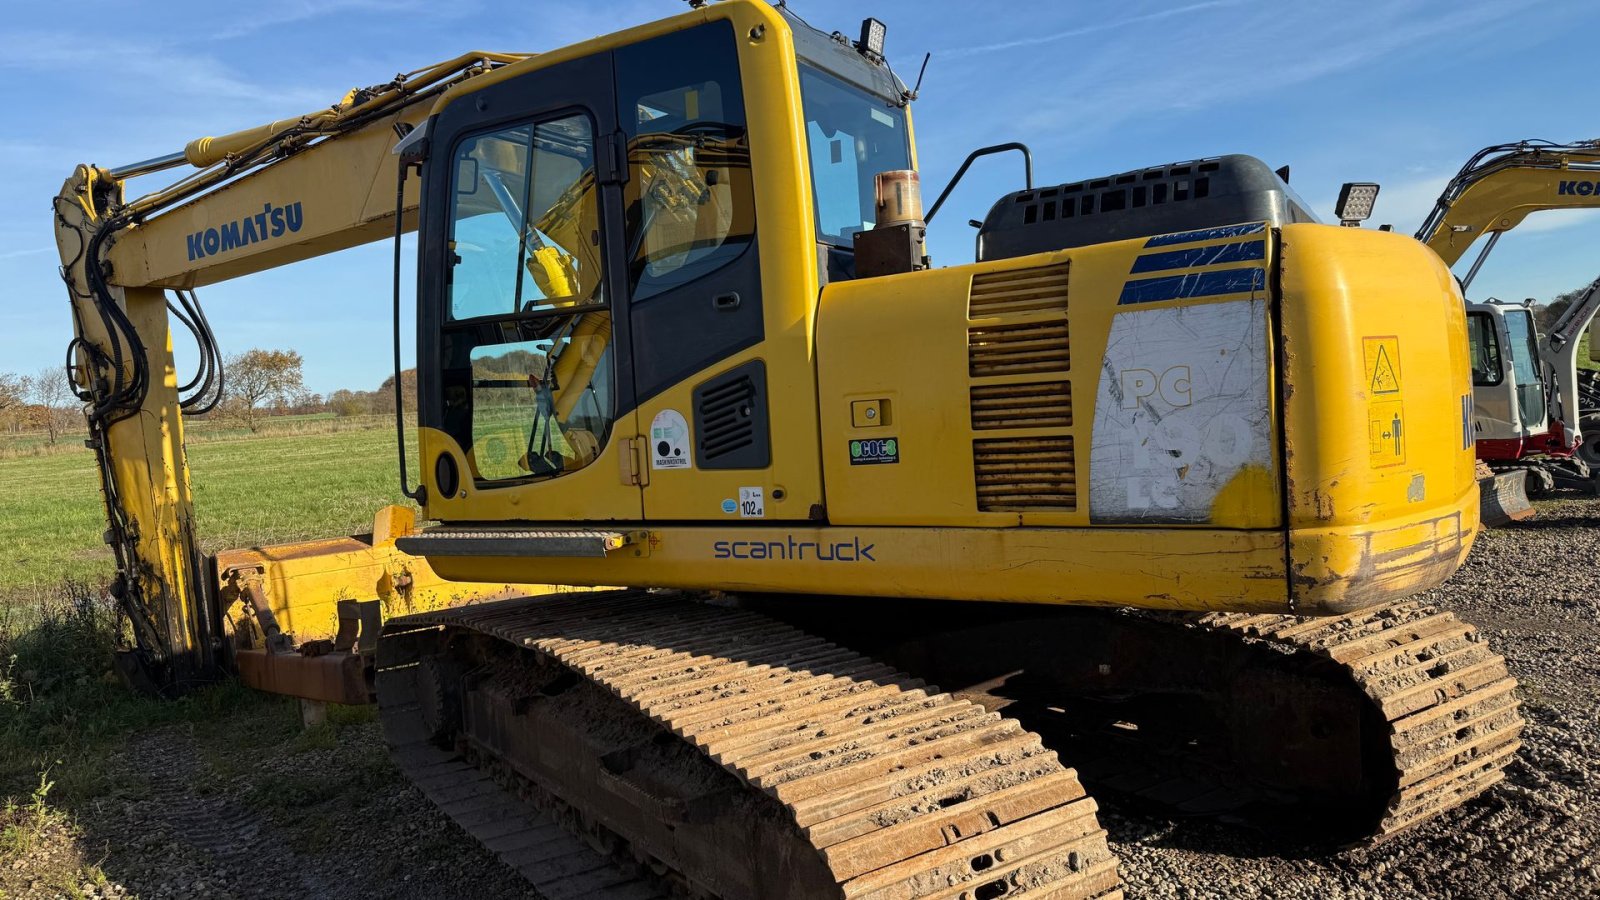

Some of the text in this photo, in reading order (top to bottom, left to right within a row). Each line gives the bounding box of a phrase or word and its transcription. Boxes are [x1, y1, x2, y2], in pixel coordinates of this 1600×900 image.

[187, 201, 304, 262] KOMATSU
[1121, 366, 1193, 411] PC
[742, 501, 756, 515] 102
[714, 535, 875, 561] scantruck
